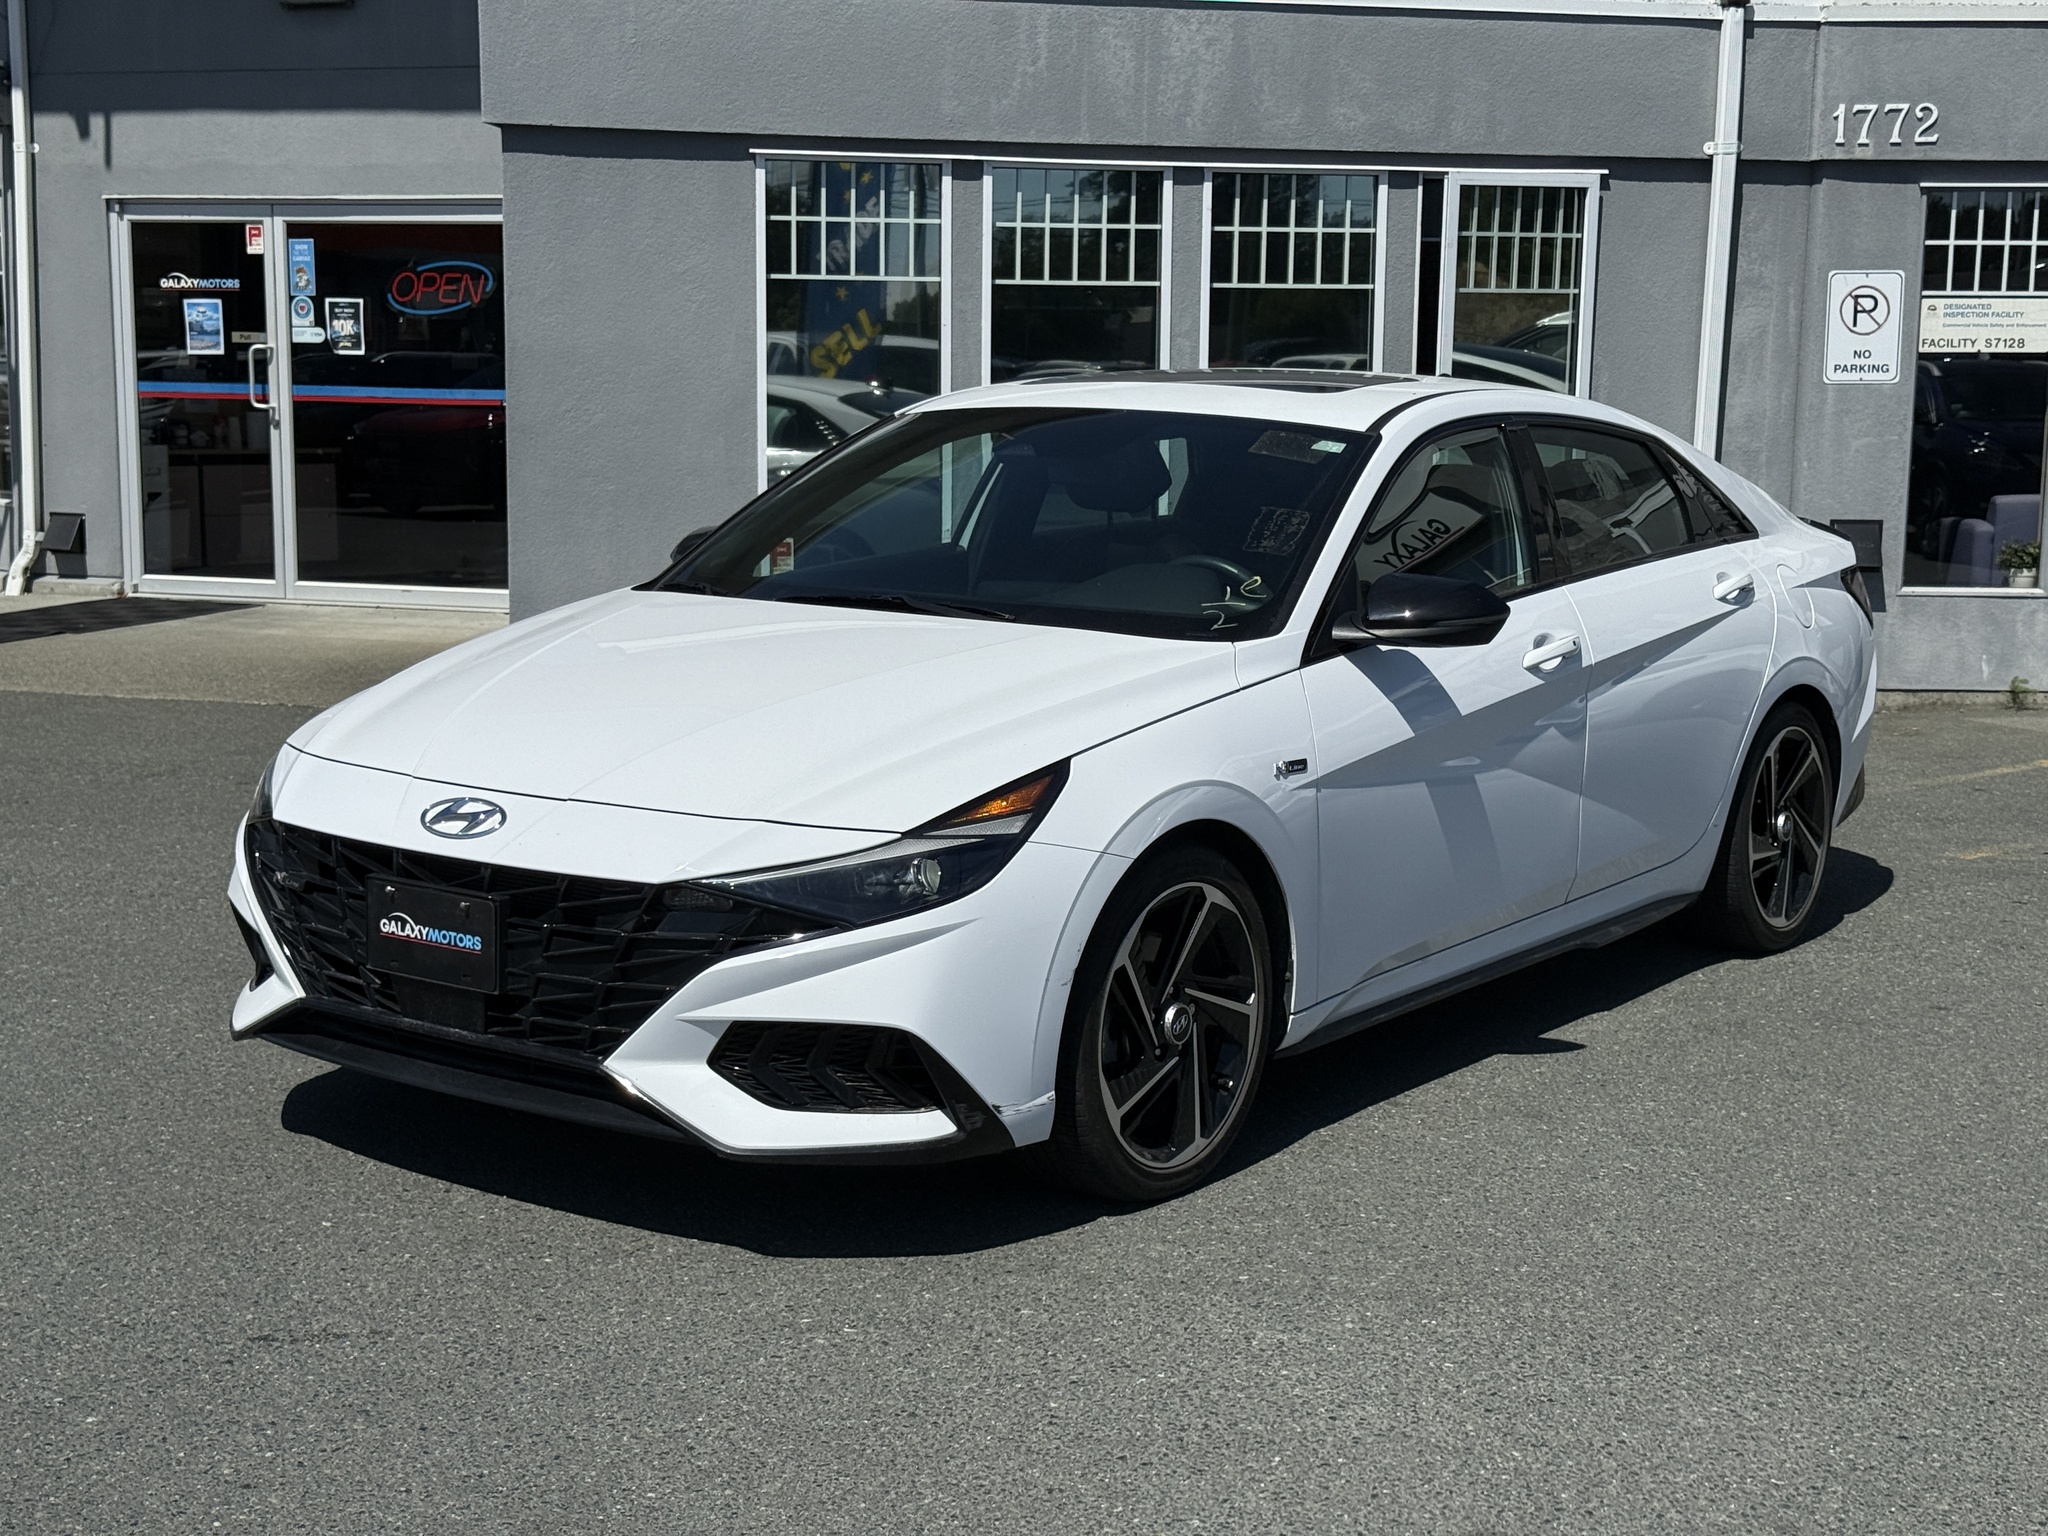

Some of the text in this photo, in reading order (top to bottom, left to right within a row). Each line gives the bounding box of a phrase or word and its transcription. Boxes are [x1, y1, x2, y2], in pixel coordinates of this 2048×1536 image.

[1832, 103, 1940, 146] 1772
[391, 271, 485, 304] OPEN
[1943, 303, 1993, 311] DESIGNATED
[1943, 311, 2025, 319] INSPECTION FACILITY
[809, 308, 883, 380] SELL
[1921, 338, 2026, 349] FACILITY S7128
[1853, 349, 1872, 360] NO
[1833, 364, 1890, 374] PARKING
